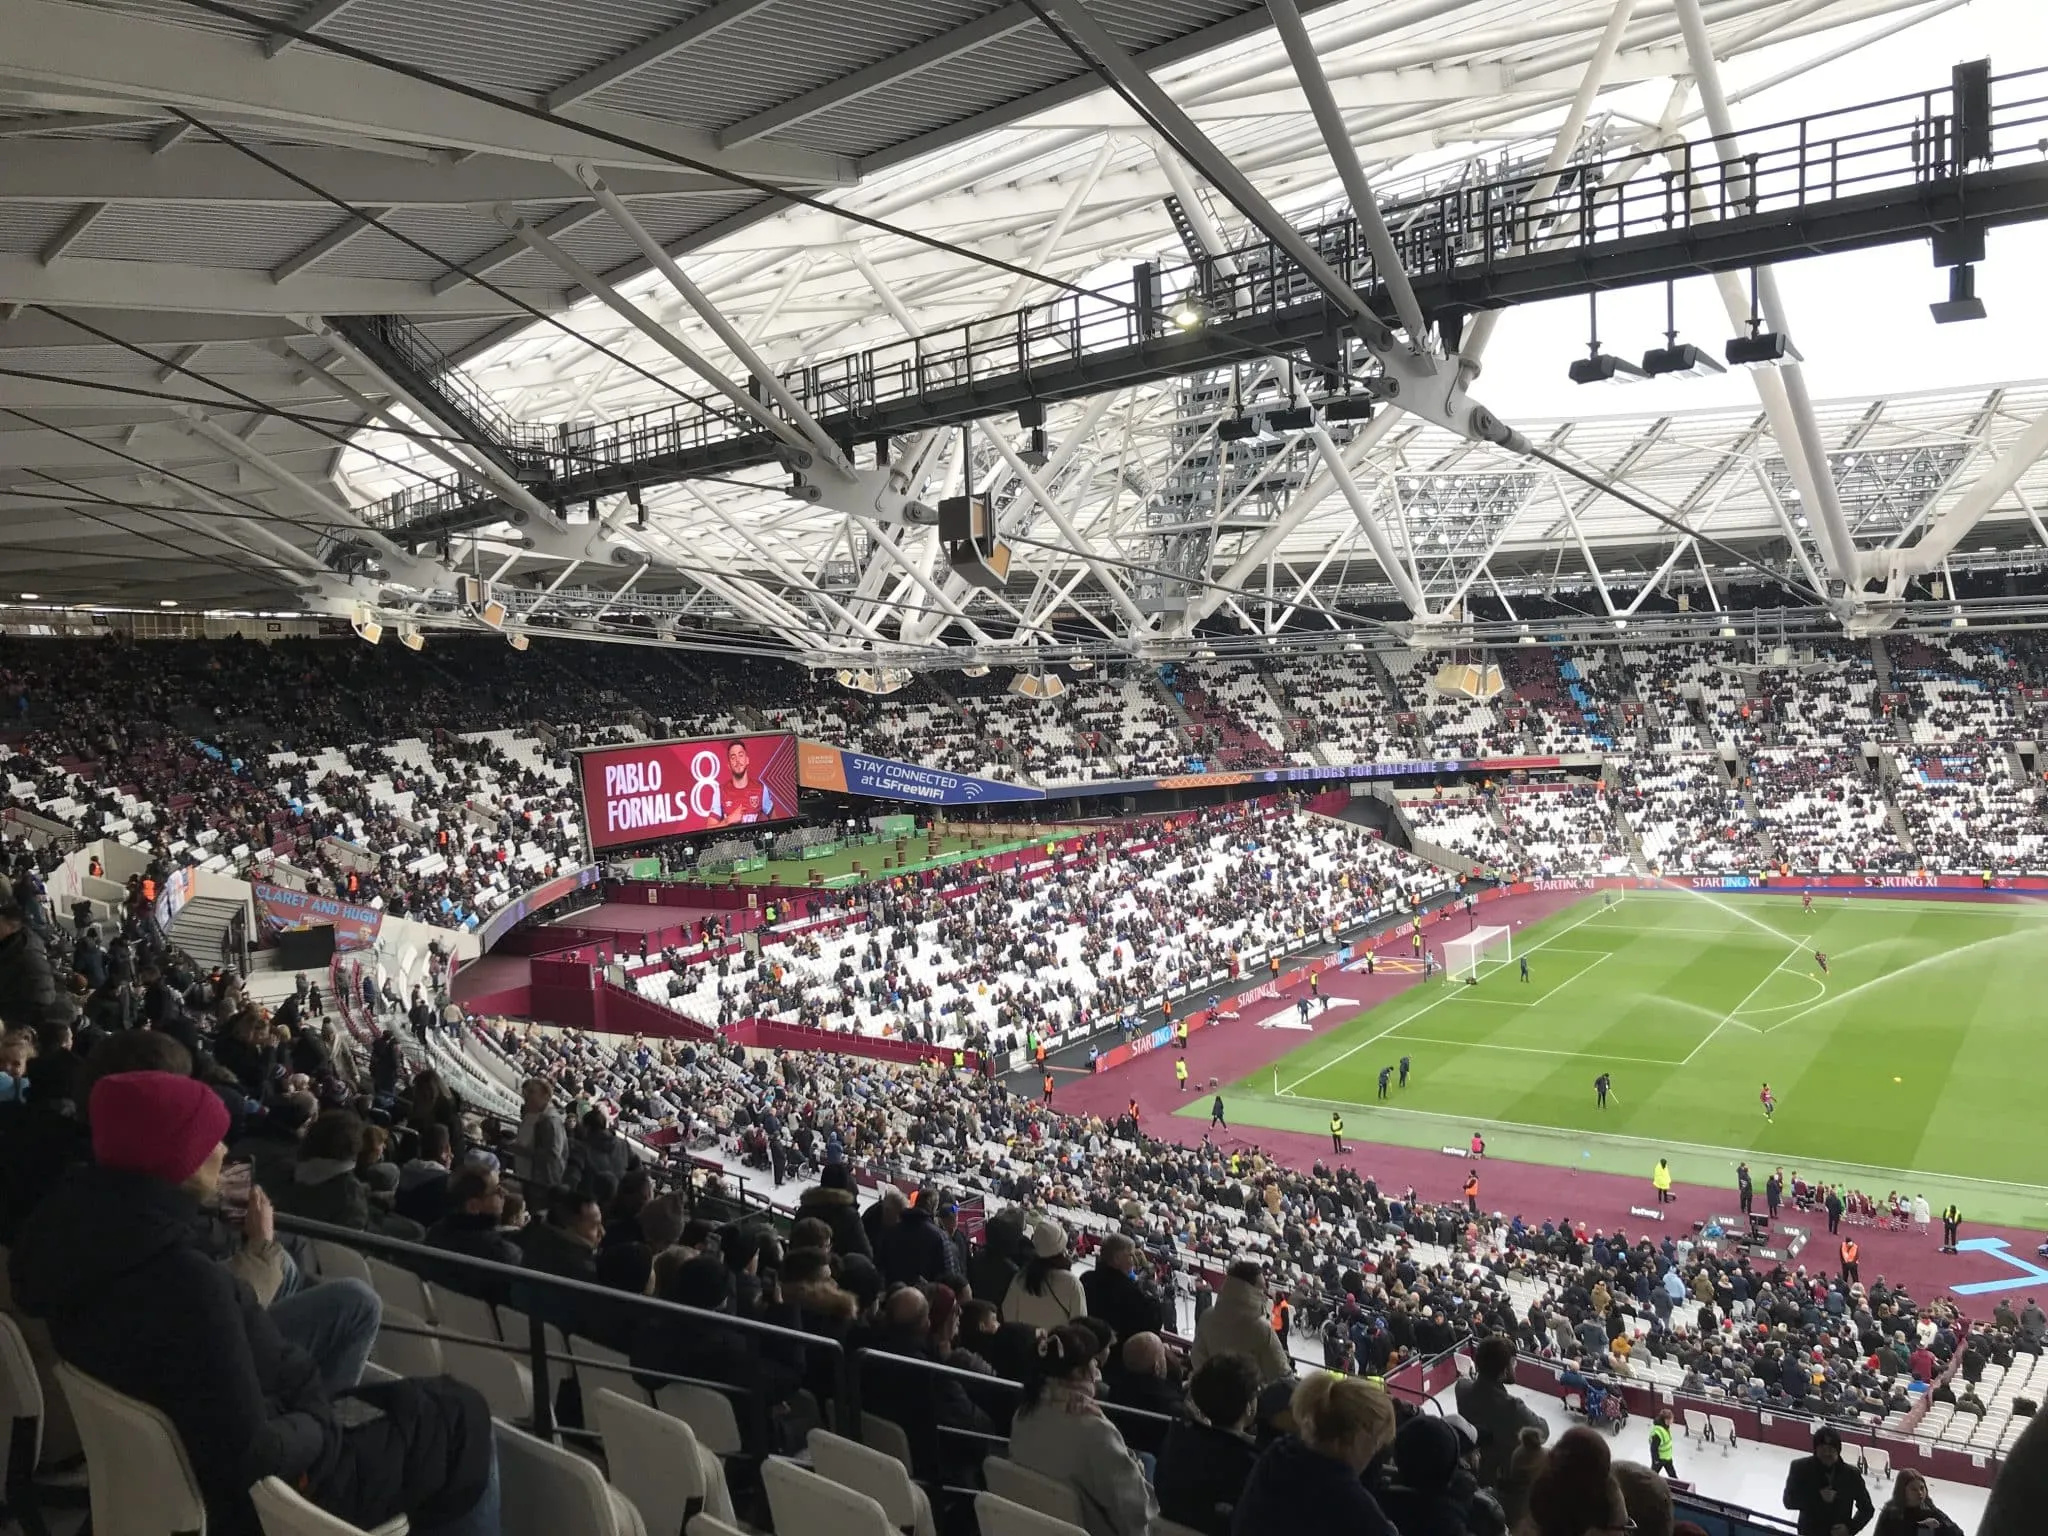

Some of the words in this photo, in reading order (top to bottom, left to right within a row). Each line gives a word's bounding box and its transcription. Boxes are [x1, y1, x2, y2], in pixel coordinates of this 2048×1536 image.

[605, 760, 662, 797] PABLO
[853, 758, 884, 774] STAY
[885, 765, 958, 789] CONNECTED
[1289, 769, 1310, 780] BIG
[1312, 767, 1346, 779] DOGS
[1350, 765, 1373, 777] FOR
[1378, 762, 1438, 776] HALFTIME
[690, 750, 721, 818] 8
[861, 775, 874, 786] at
[607, 791, 689, 832] FORNALS
[1693, 876, 1747, 888] STARTING
[1748, 876, 1760, 888] XI
[1926, 876, 1938, 888] XI
[255, 885, 308, 908] CLARET
[312, 900, 340, 916] AND
[343, 905, 379, 924] HUGH
[1131, 1024, 1170, 1057] STARTING
[1631, 1204, 1660, 1219] betway
[1718, 1216, 1735, 1226] VAR
[1783, 1226, 1800, 1236] VAR
[1701, 1239, 1718, 1249] VAR
[1759, 1249, 1777, 1259] VAR
